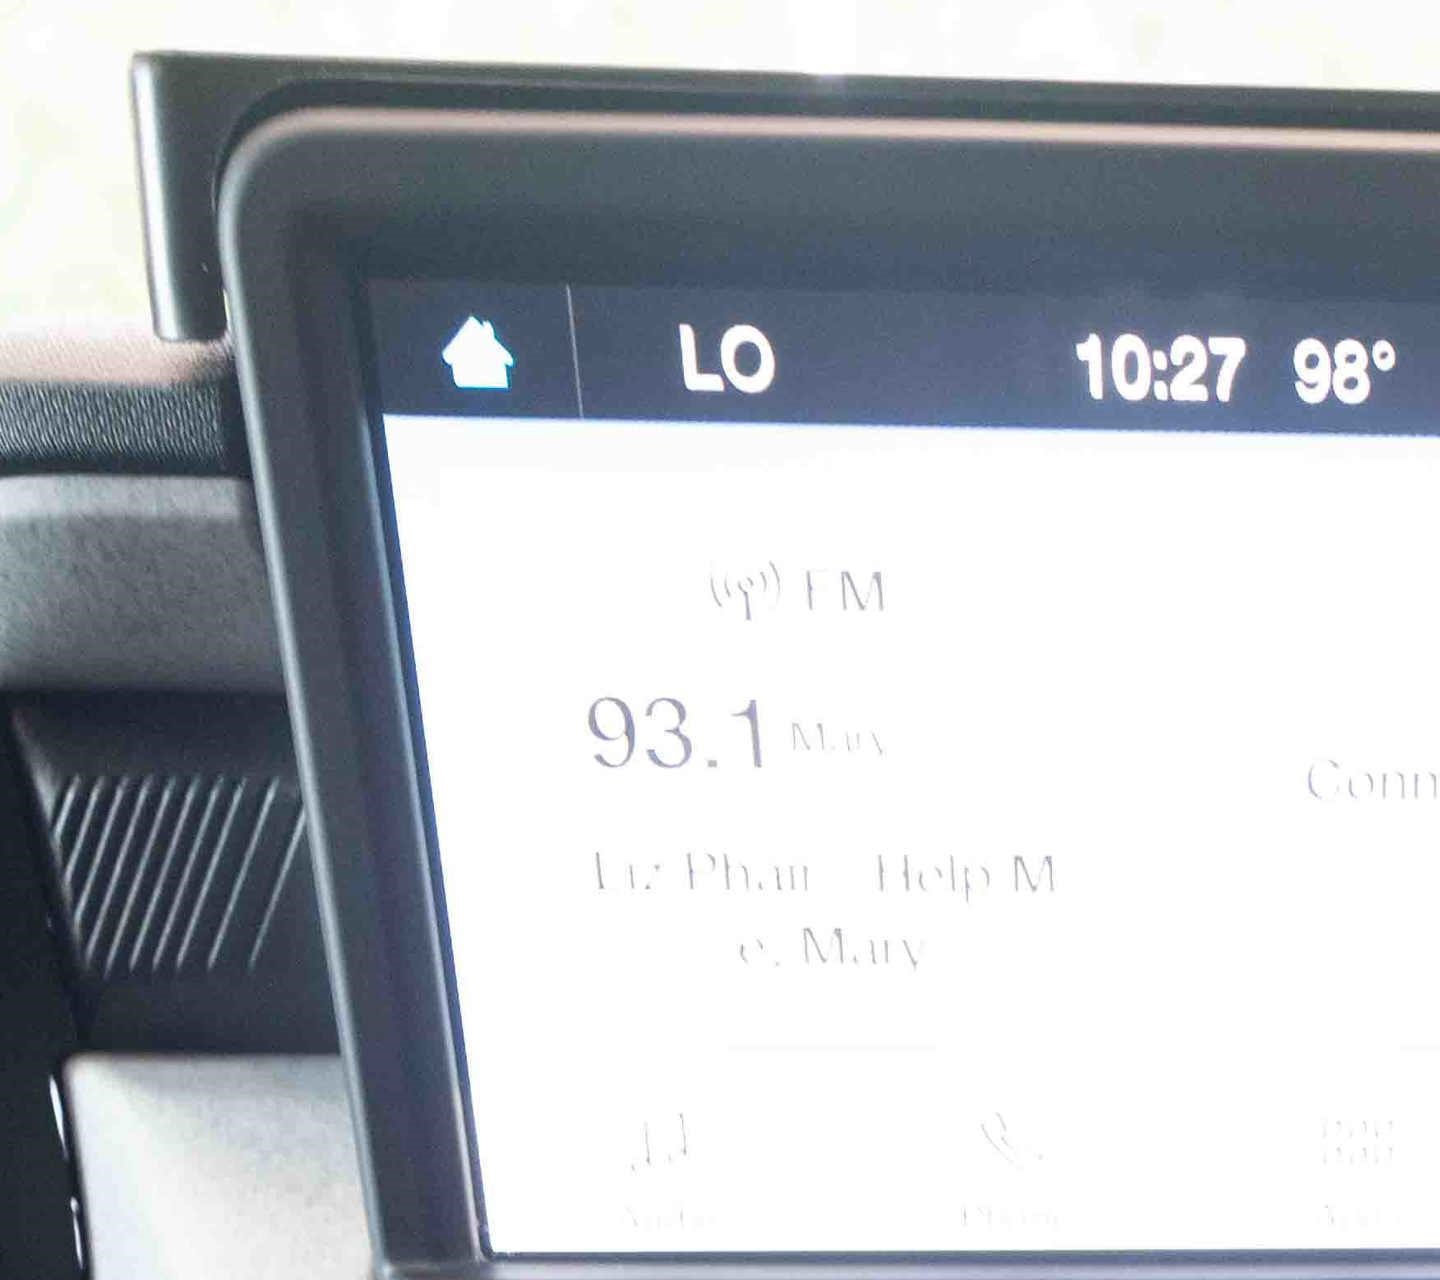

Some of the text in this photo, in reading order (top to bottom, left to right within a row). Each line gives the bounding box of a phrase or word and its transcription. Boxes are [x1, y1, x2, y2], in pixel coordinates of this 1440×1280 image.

[679, 324, 776, 393] LO
[1077, 334, 1246, 402] 10:27
[587, 696, 763, 768] 93.1
